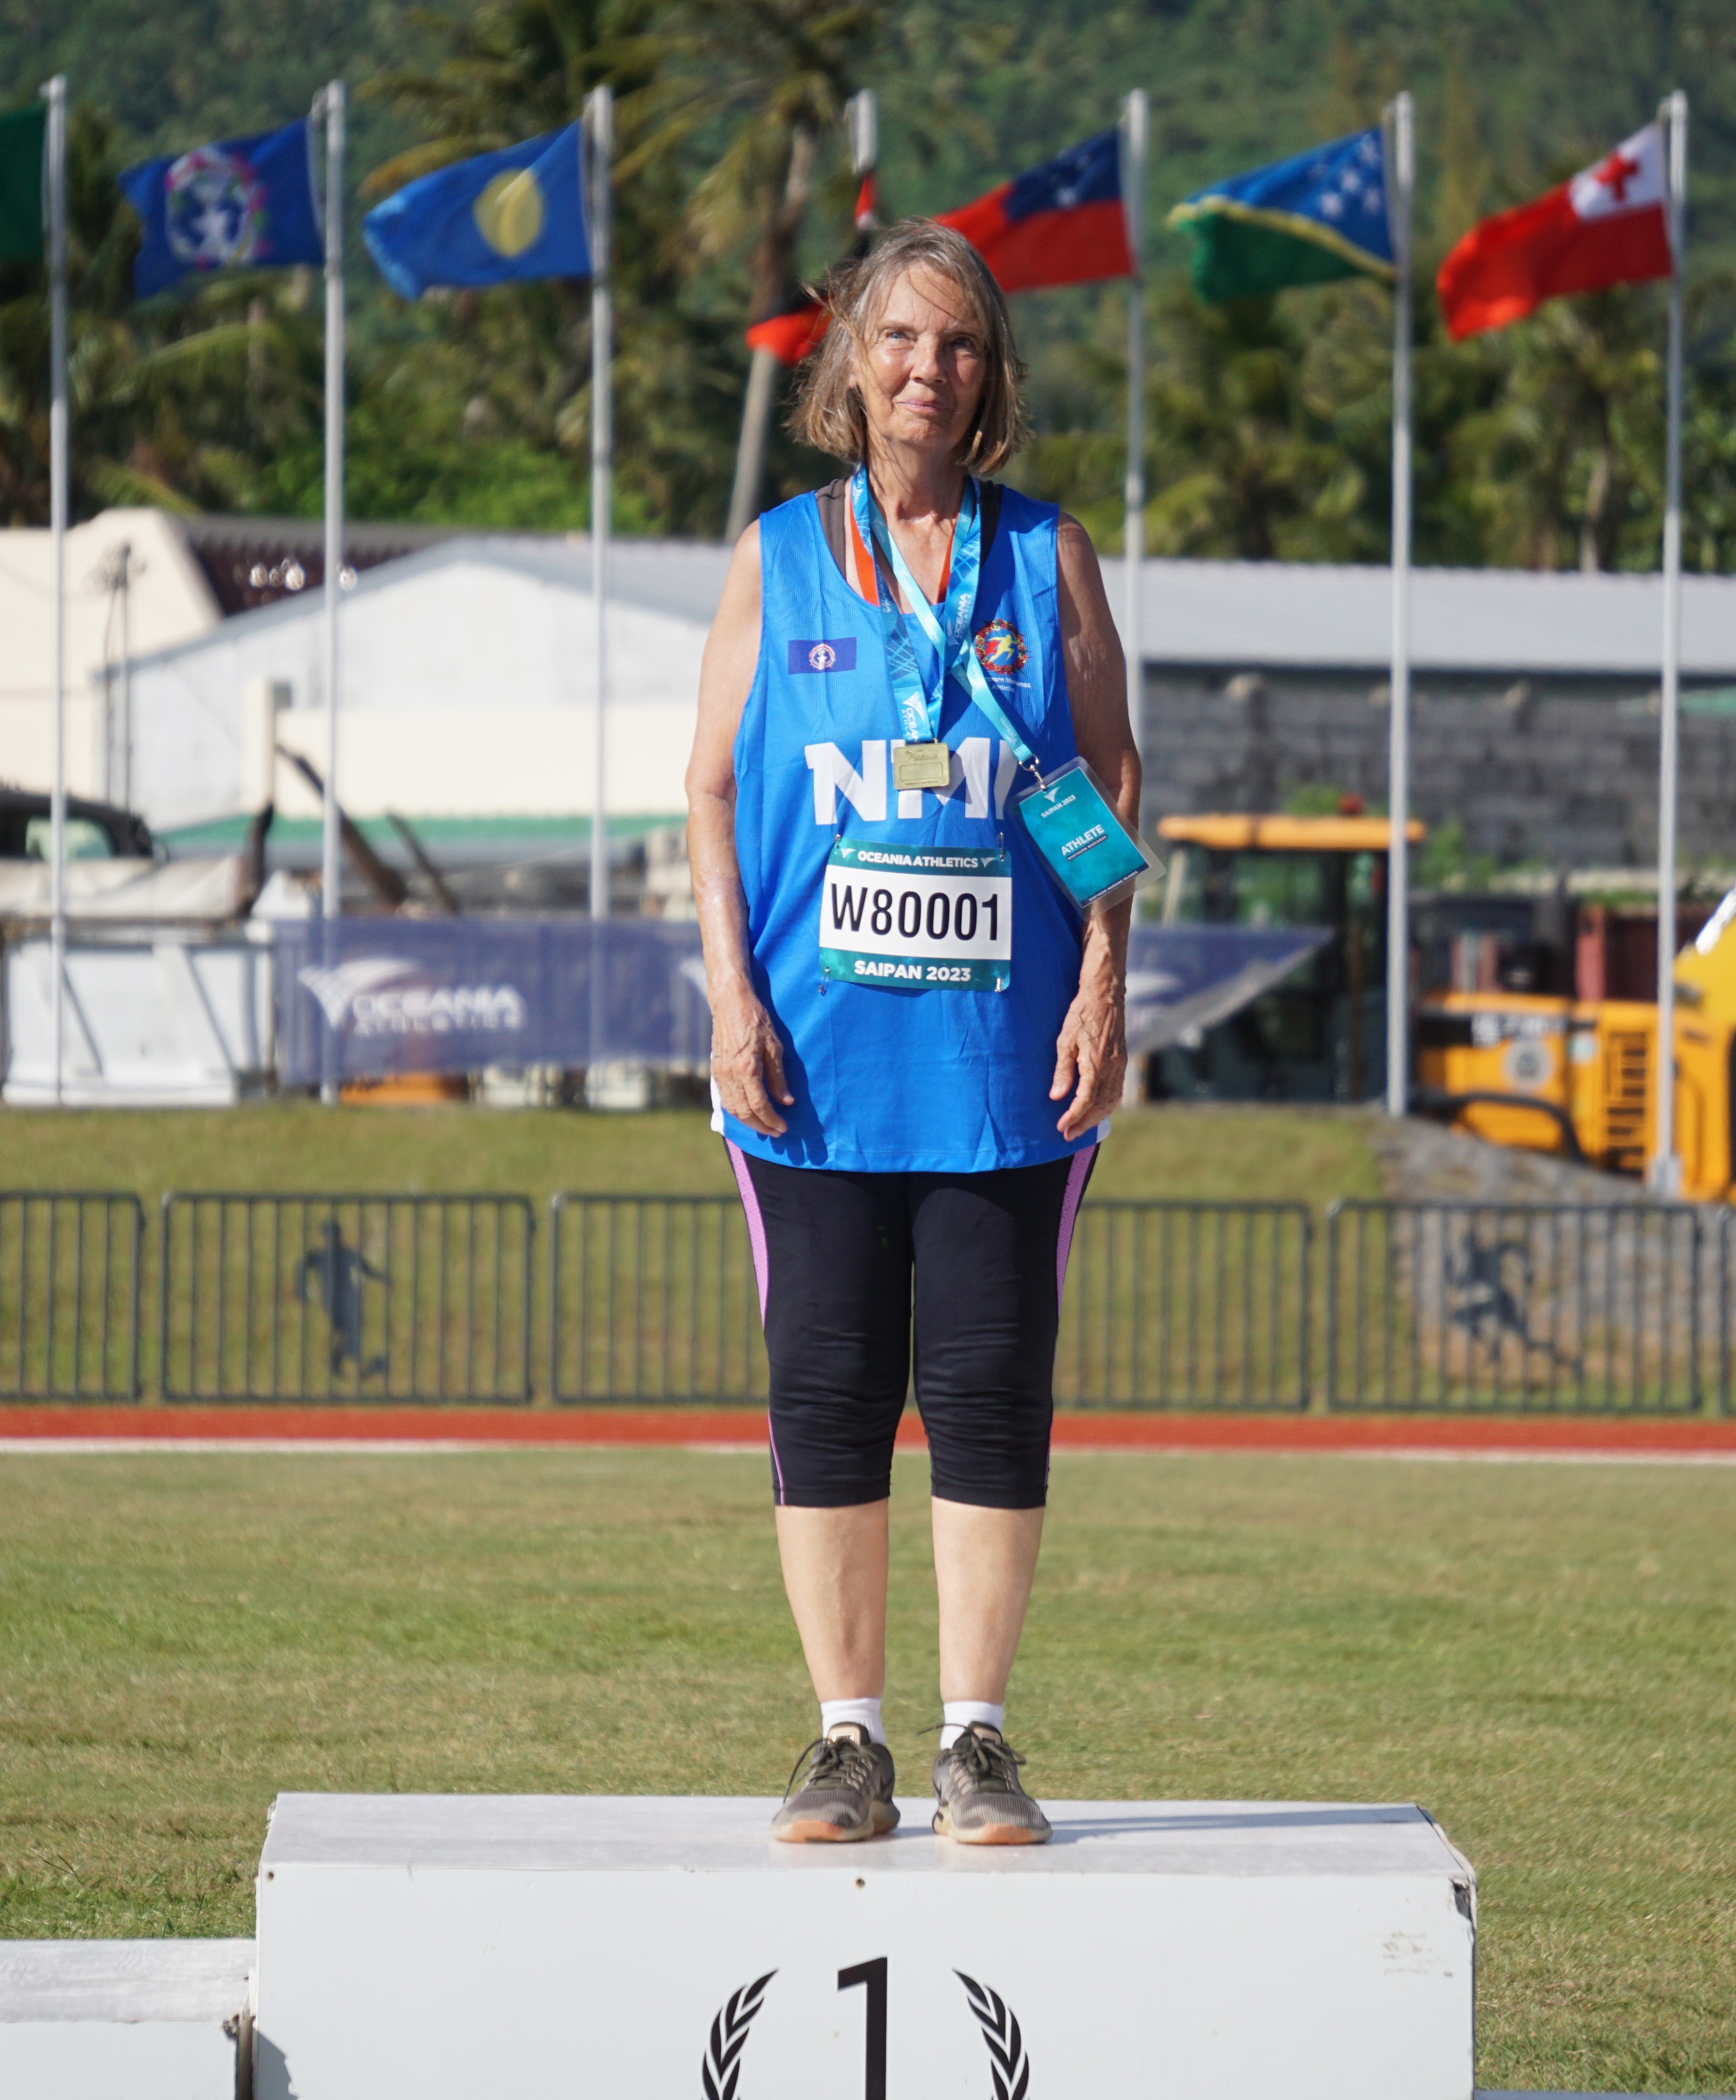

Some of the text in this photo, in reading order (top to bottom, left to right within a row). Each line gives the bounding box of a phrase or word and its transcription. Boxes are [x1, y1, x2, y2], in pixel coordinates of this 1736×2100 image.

[1040, 794, 1076, 818] SAIPAN 2023
[1060, 824, 1105, 856] ATHLETE
[857, 850, 979, 868] OCEANIA ATHLETICS
[830, 883, 998, 941] W80001
[854, 960, 972, 982] SAIPAN 2023
[352, 985, 522, 1018] OCEANIA
[837, 1956, 888, 2100] 1
